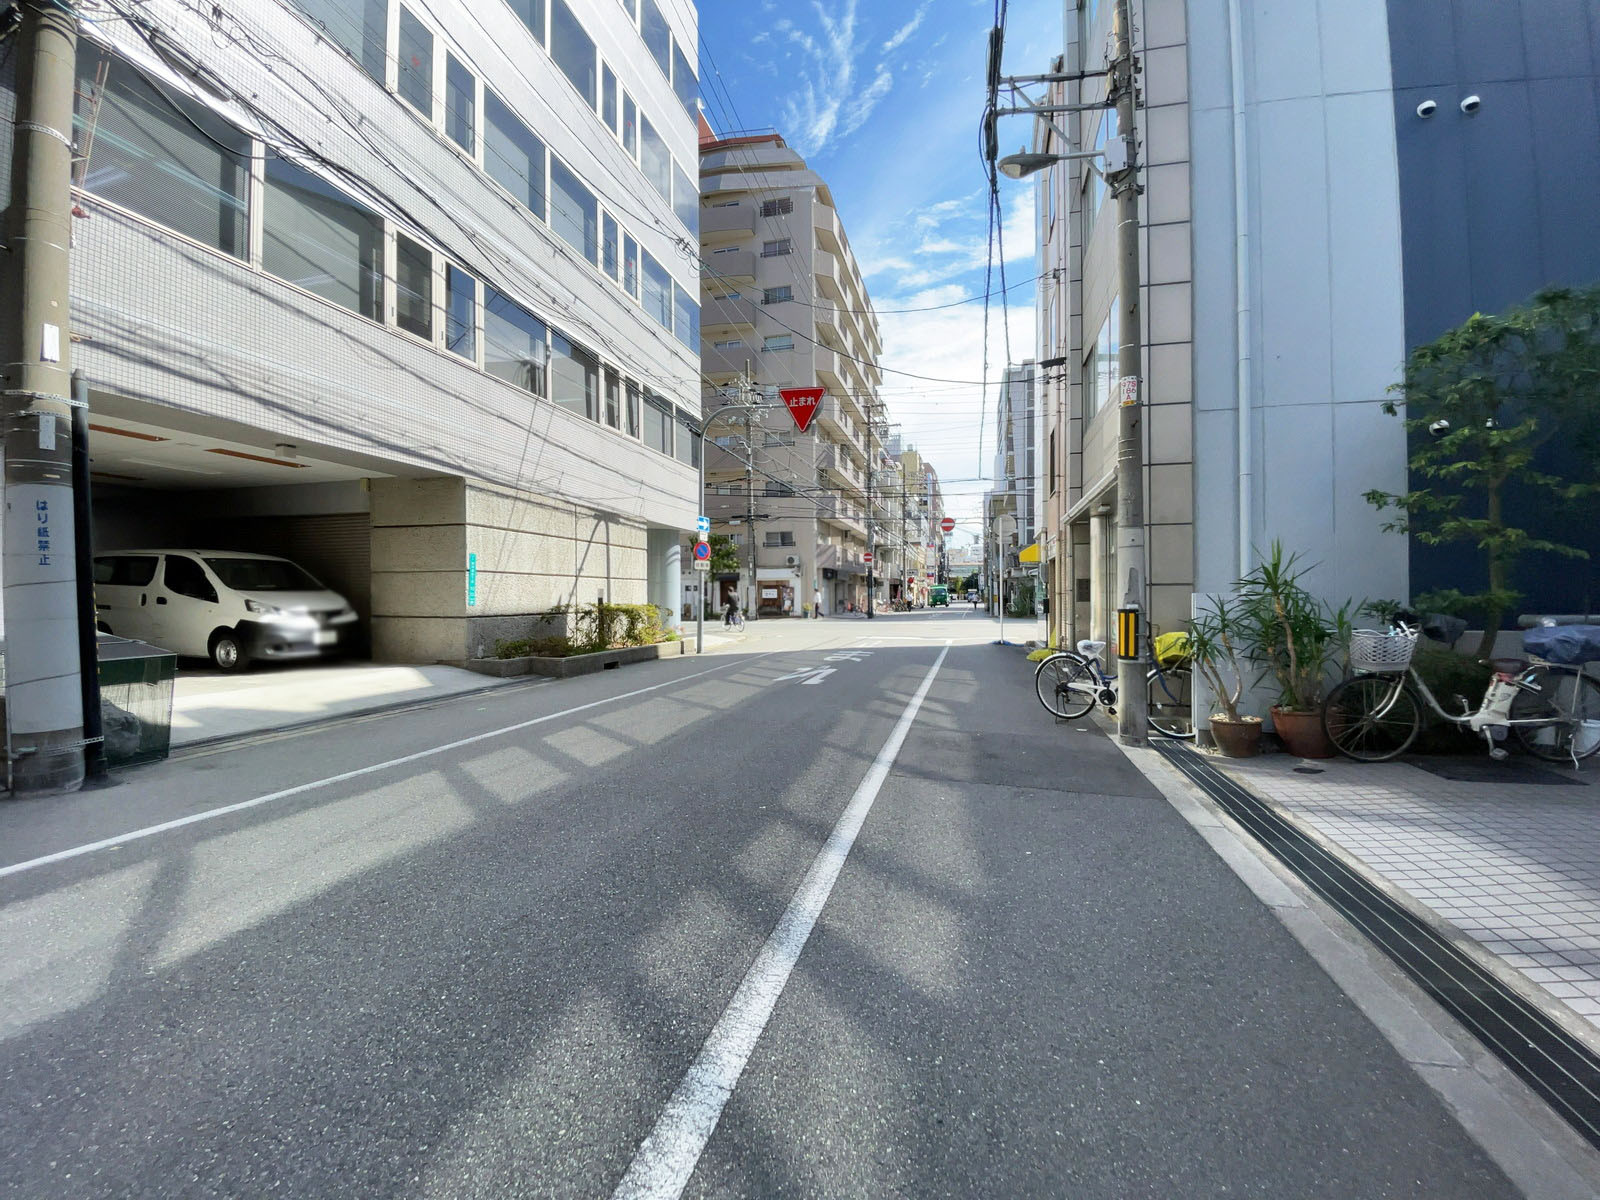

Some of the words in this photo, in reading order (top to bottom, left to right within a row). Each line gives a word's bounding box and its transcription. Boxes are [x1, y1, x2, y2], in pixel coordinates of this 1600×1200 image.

[790, 396, 816, 407] 止まれ
[36, 500, 50, 566] はり紙禁止
